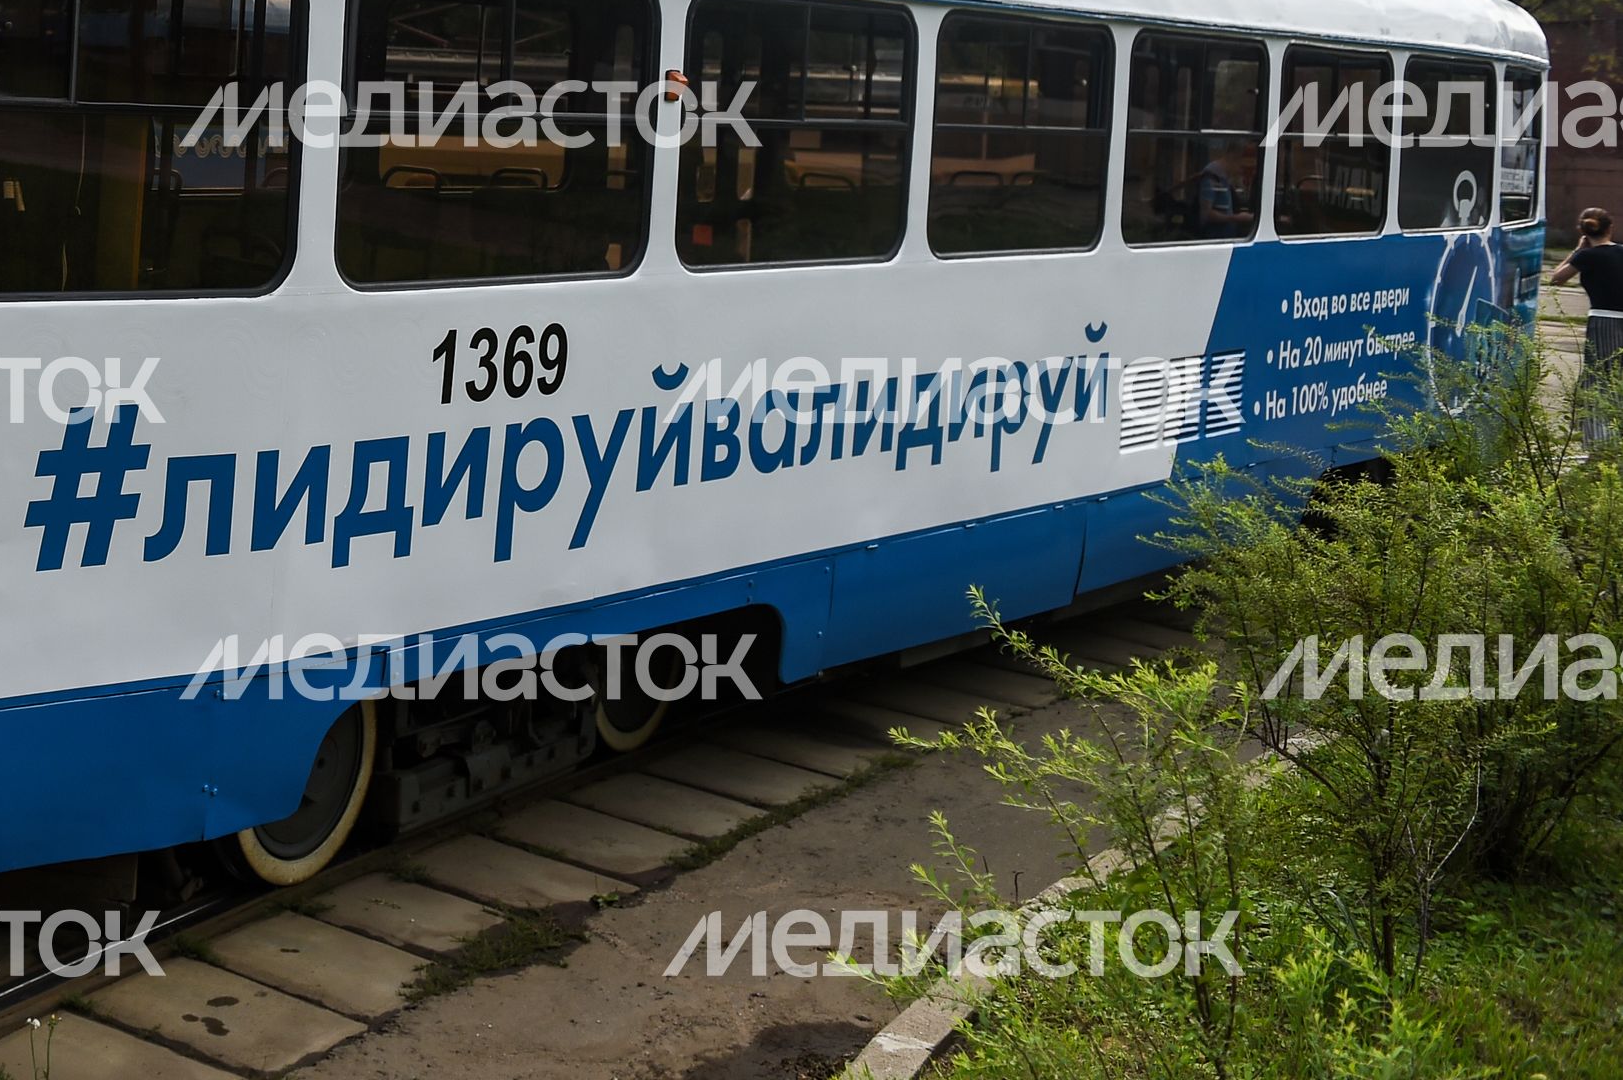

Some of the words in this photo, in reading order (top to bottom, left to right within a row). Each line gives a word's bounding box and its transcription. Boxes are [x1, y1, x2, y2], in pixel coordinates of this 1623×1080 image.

[1293, 289, 1328, 321] Вход
[1331, 294, 1347, 315] во
[1350, 292, 1370, 313] все
[1372, 287, 1410, 317] двери
[431, 322, 568, 404] 1369
[1278, 340, 1300, 370] На
[1304, 336, 1322, 367] 20
[1323, 338, 1364, 368] минут
[1366, 326, 1416, 360] быстрее
[1265, 390, 1286, 421] На
[1292, 381, 1329, 416] 100%
[1331, 372, 1388, 417] удобнее
[23, 321, 1110, 573] #лидируйвалидируй
